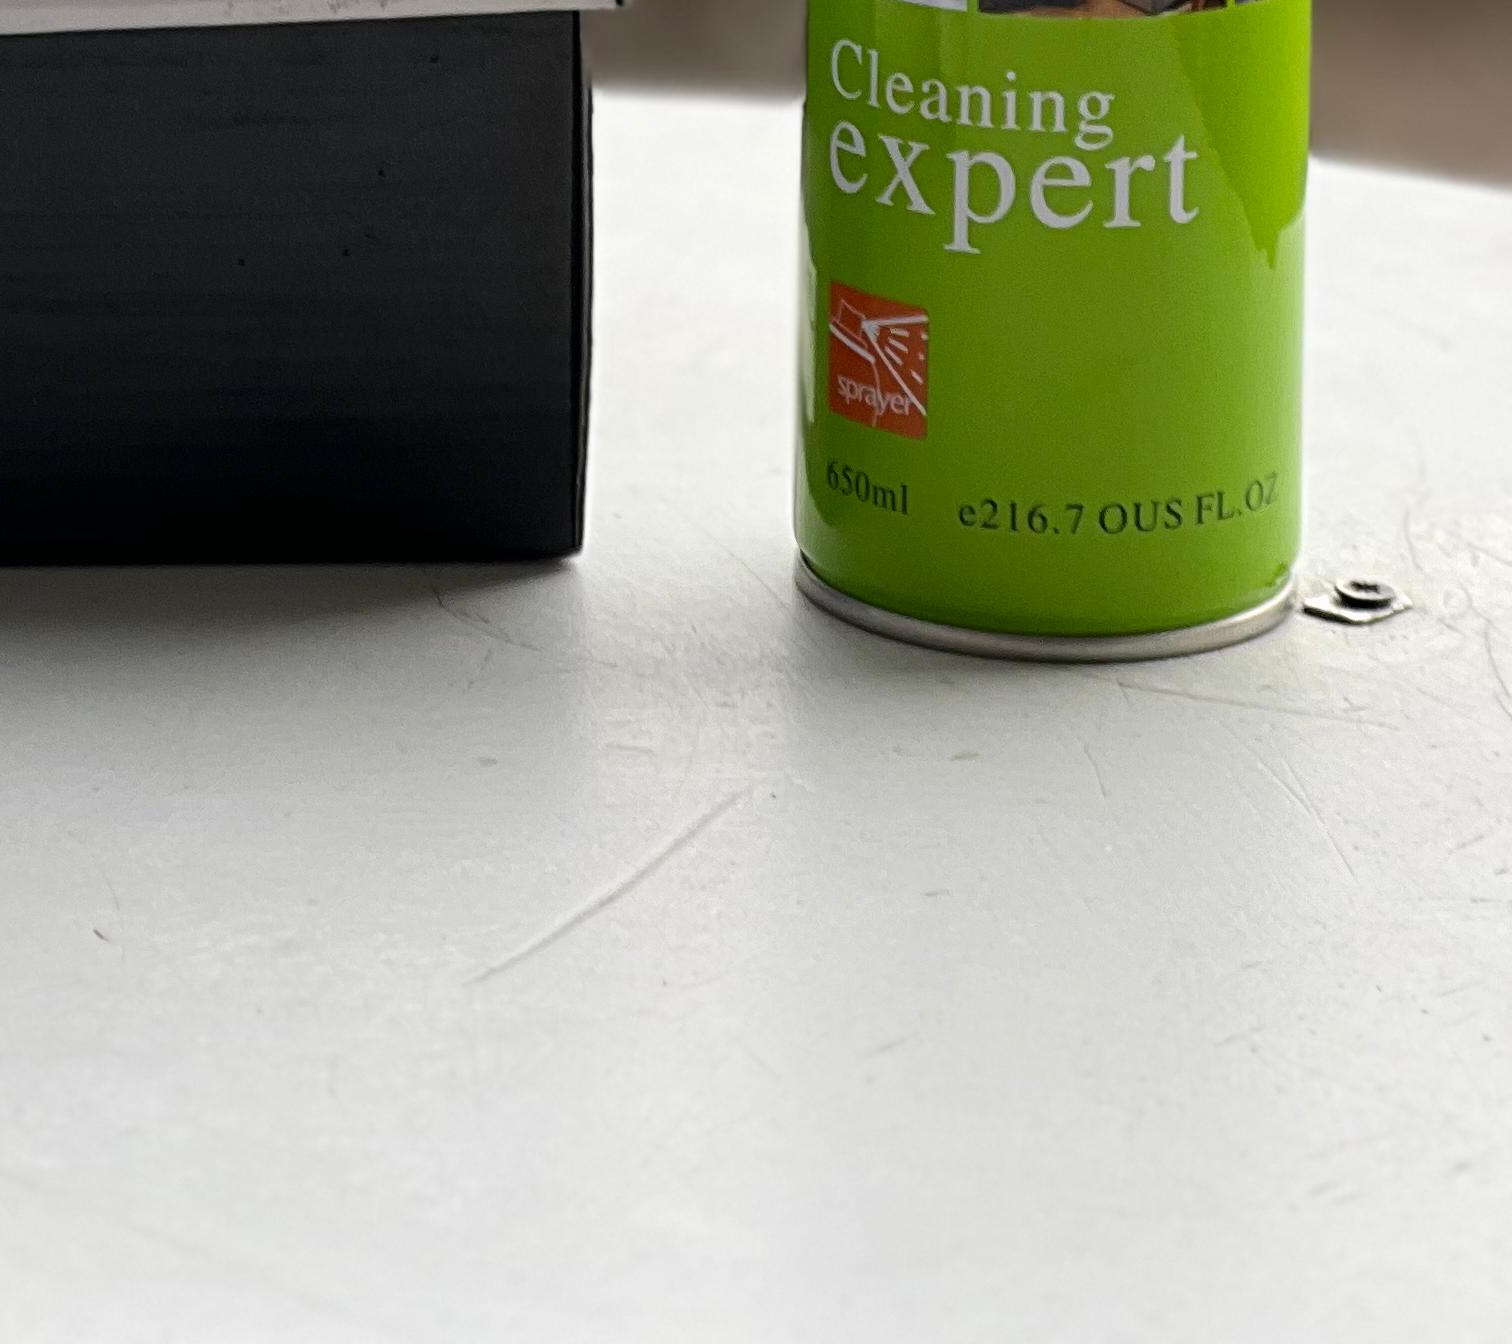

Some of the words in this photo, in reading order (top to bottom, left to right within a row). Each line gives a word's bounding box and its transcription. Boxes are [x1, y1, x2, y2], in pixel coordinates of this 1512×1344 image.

[830, 38, 1116, 150] Cleaning
[828, 120, 1200, 255] expert
[838, 374, 911, 418] sprayer
[826, 458, 909, 516] 650ml
